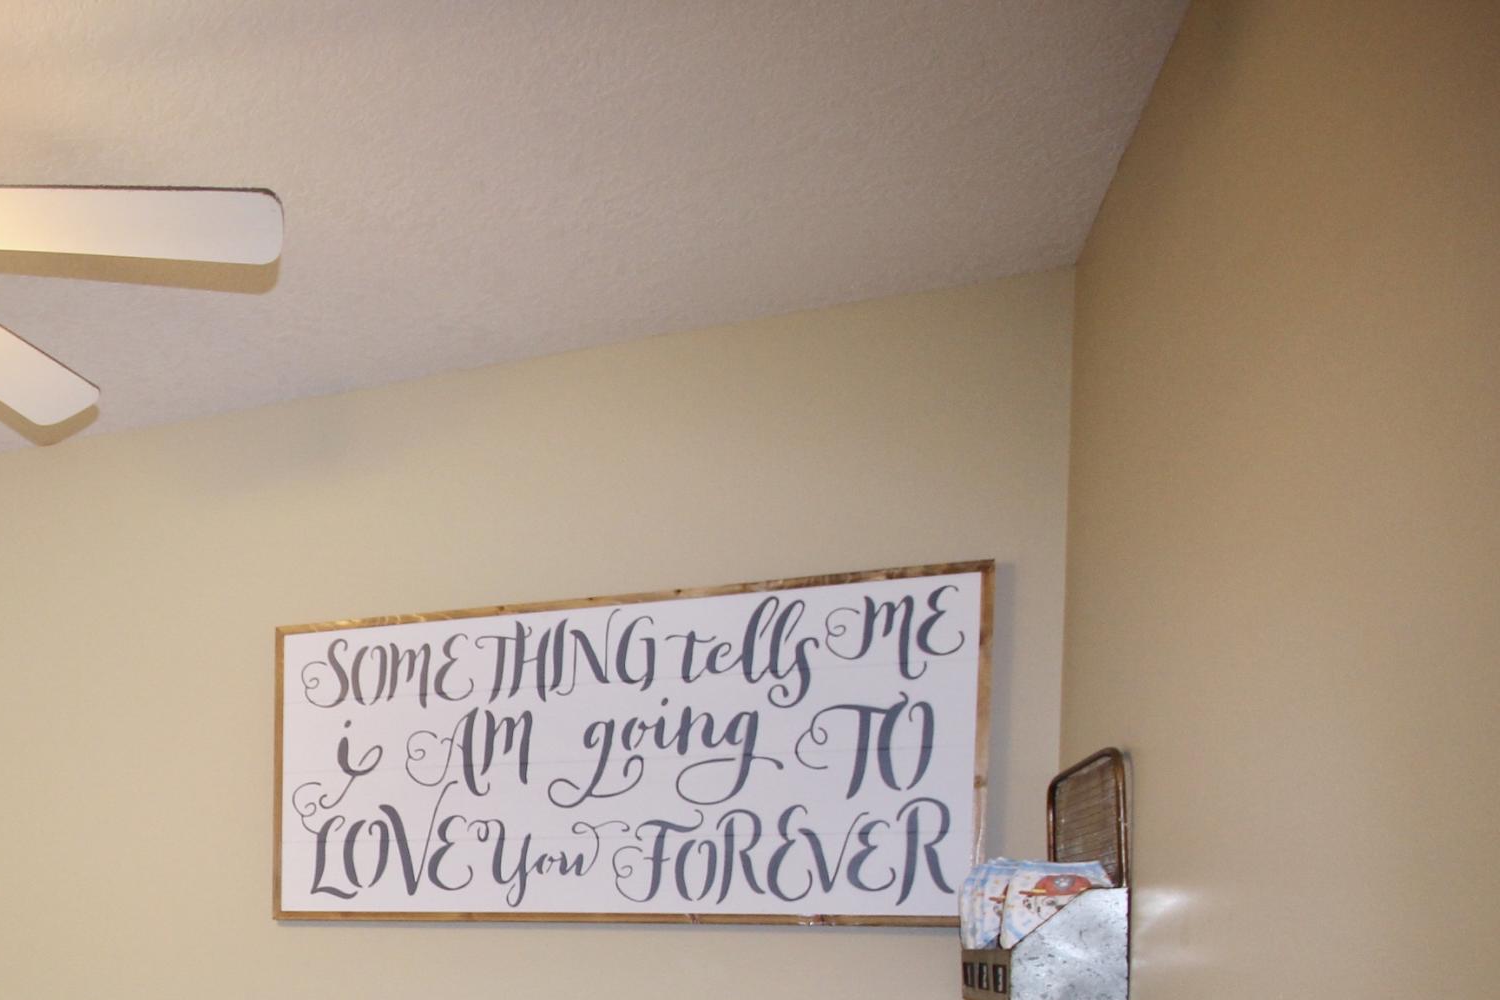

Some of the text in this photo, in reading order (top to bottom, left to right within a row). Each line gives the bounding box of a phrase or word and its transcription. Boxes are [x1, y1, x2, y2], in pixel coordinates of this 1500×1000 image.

[304, 585, 966, 709] SOMETHING tells ME
[318, 691, 935, 809] i AM going TO
[293, 780, 474, 902] LOVE
[612, 797, 955, 904] FOREVER
